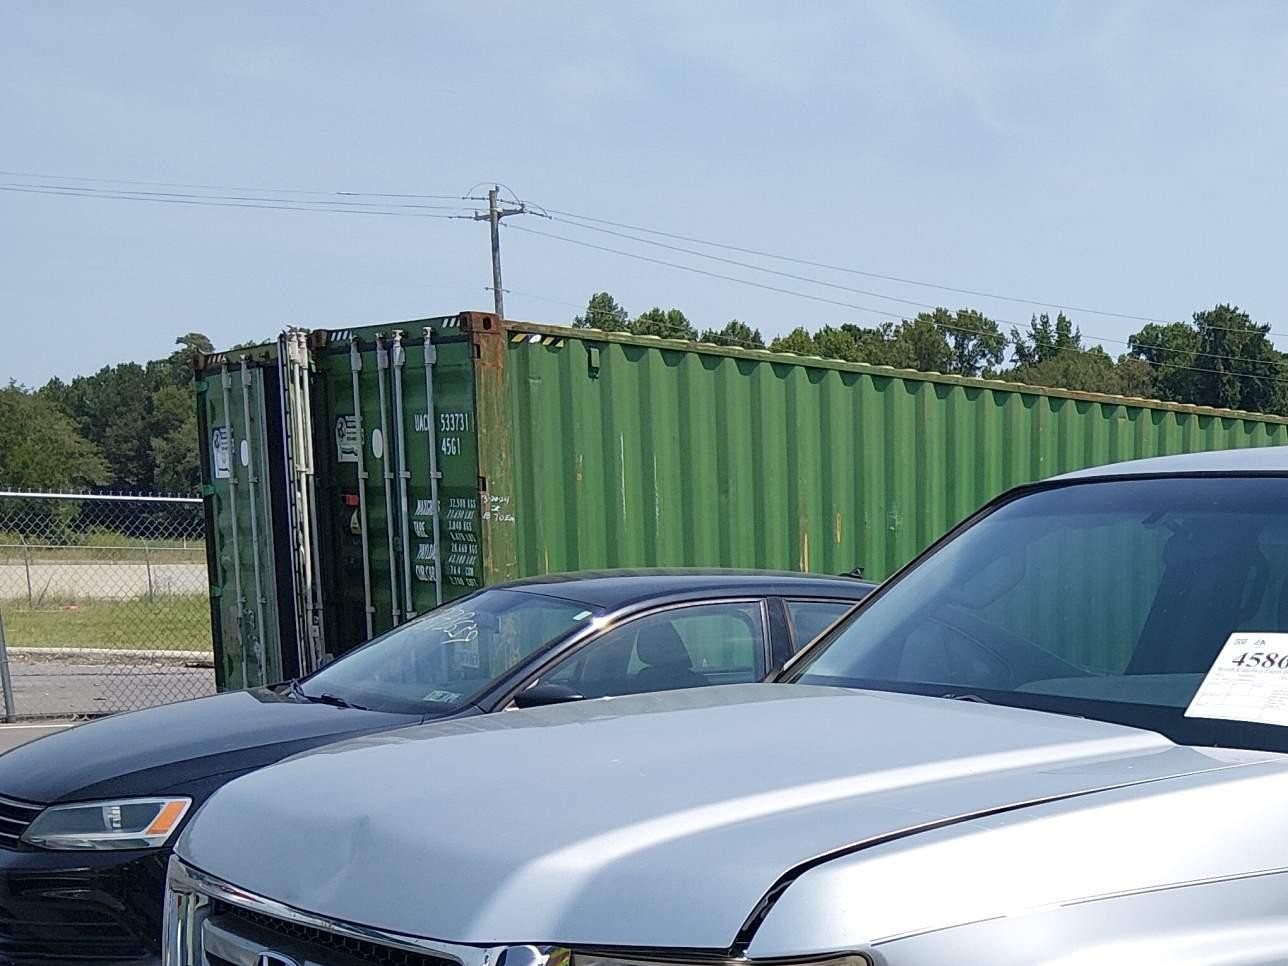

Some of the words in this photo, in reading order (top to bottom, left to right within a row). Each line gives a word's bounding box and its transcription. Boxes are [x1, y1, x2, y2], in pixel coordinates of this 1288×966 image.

[414, 414, 429, 431] UAC
[440, 413, 468, 431] 533731
[441, 437, 460, 455] 45G1
